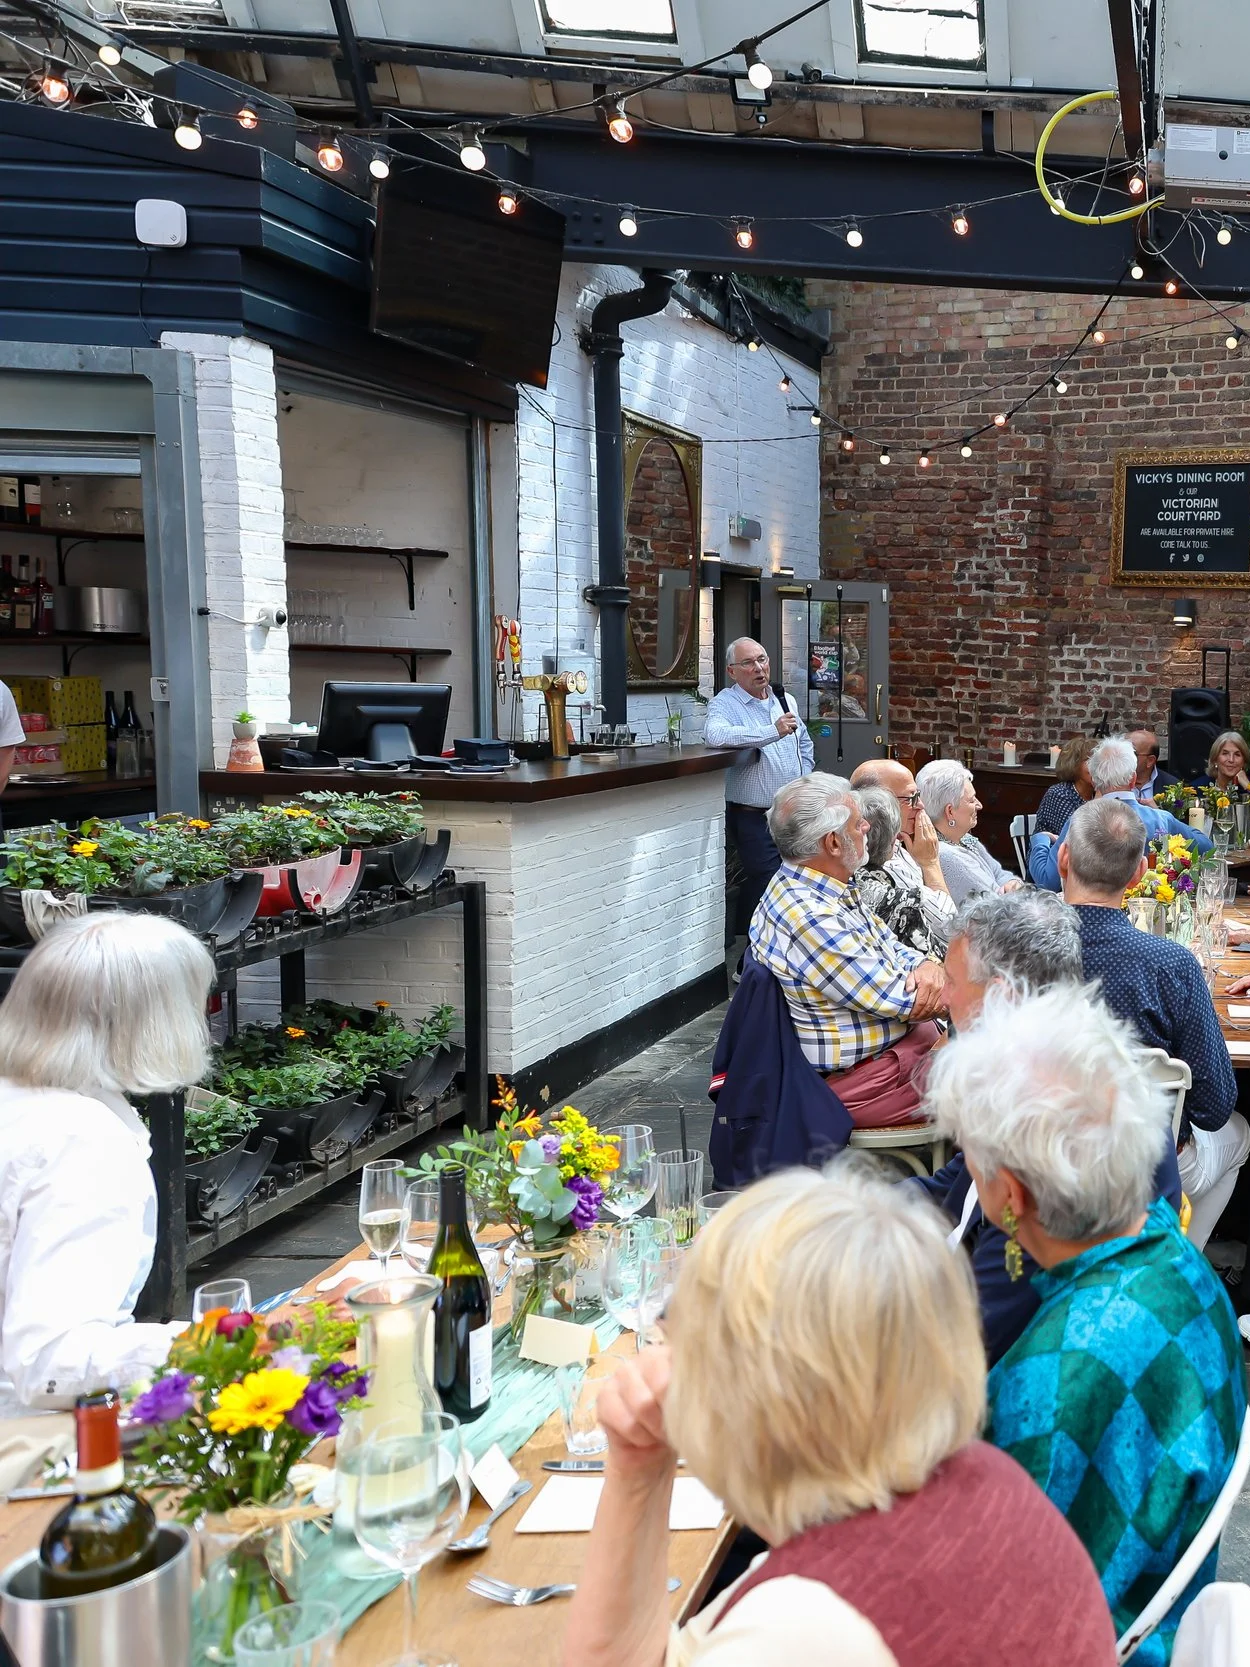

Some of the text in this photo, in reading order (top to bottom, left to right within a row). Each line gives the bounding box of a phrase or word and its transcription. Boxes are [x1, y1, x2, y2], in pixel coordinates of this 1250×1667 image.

[1176, 472, 1212, 483] DINING
[1215, 471, 1245, 482] ROOM
[1186, 487, 1198, 495] OUR
[1161, 498, 1218, 509] VICTORIAN
[1157, 511, 1221, 521] COURTYARD
[1140, 527, 1235, 536] ARE AVAILABLE FOR PRIVATE HIRE
[1160, 540, 1175, 549] COME
[1176, 540, 1191, 549] TALK
[1192, 540, 1200, 549] TO
